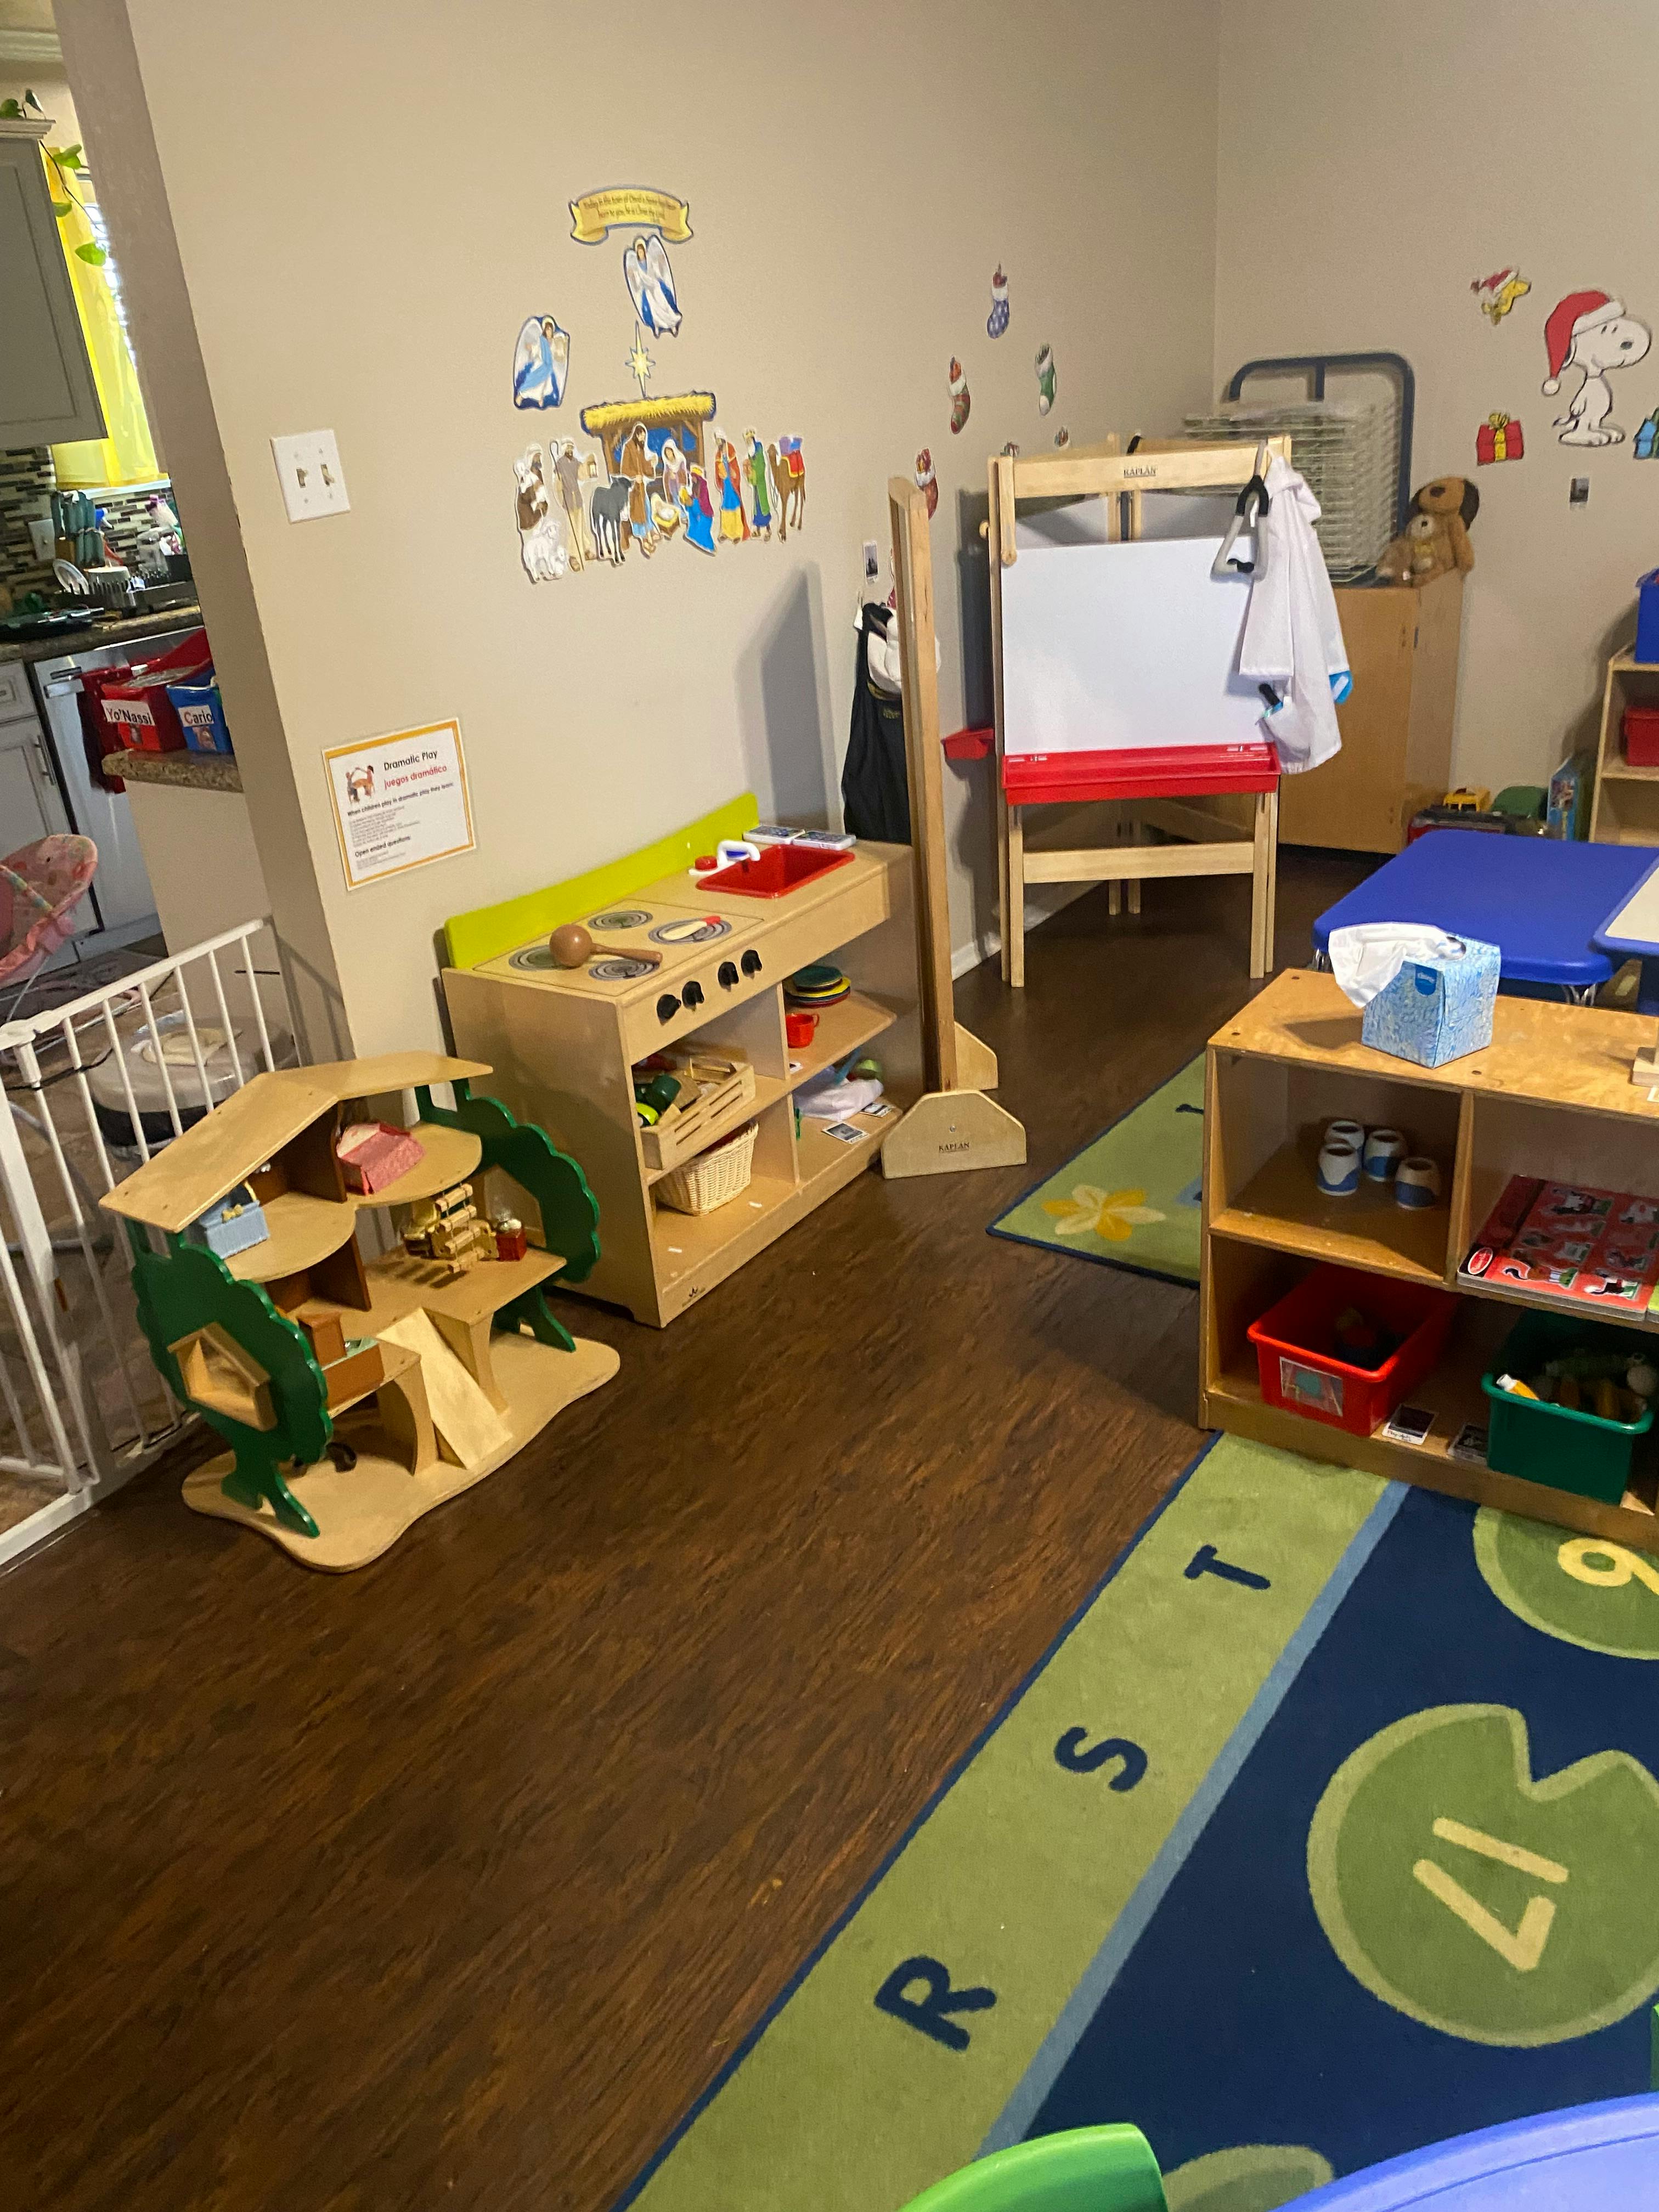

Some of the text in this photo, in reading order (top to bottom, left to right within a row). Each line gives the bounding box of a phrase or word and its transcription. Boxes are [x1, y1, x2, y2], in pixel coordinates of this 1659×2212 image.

[1124, 466, 1156, 476] KAPLAN
[383, 750, 438, 771] Dramatic Play
[362, 803, 381, 812] children
[381, 799, 392, 808] play
[355, 849, 369, 857] Open
[939, 1142, 969, 1152] KAPLAN
[873, 1544, 1271, 2051] R S T
